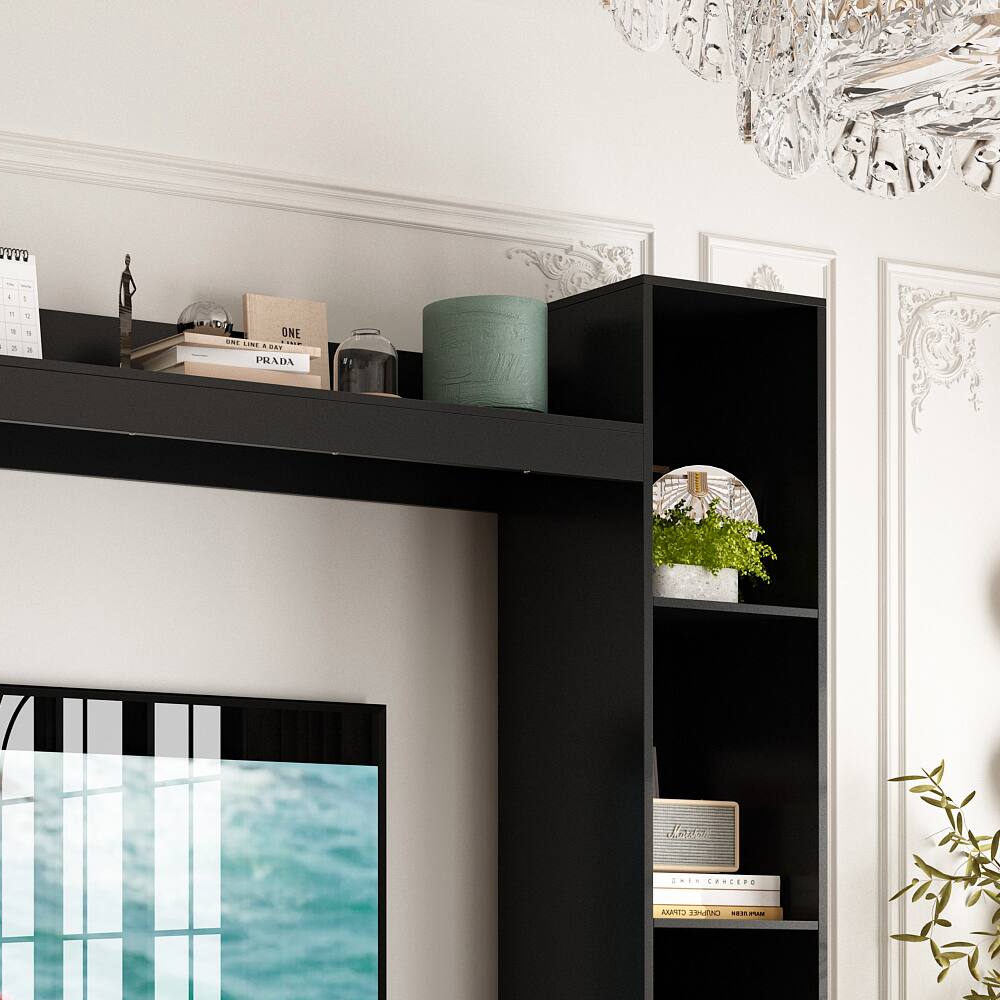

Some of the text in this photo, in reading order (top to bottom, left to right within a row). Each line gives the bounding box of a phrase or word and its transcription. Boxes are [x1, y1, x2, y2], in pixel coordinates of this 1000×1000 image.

[281, 326, 301, 339] ONE
[225, 338, 240, 347] ONE
[243, 341, 260, 349] LINE
[269, 343, 283, 351] DAY
[255, 355, 295, 366] PRADA
[707, 878, 756, 886] СИНСЕРО
